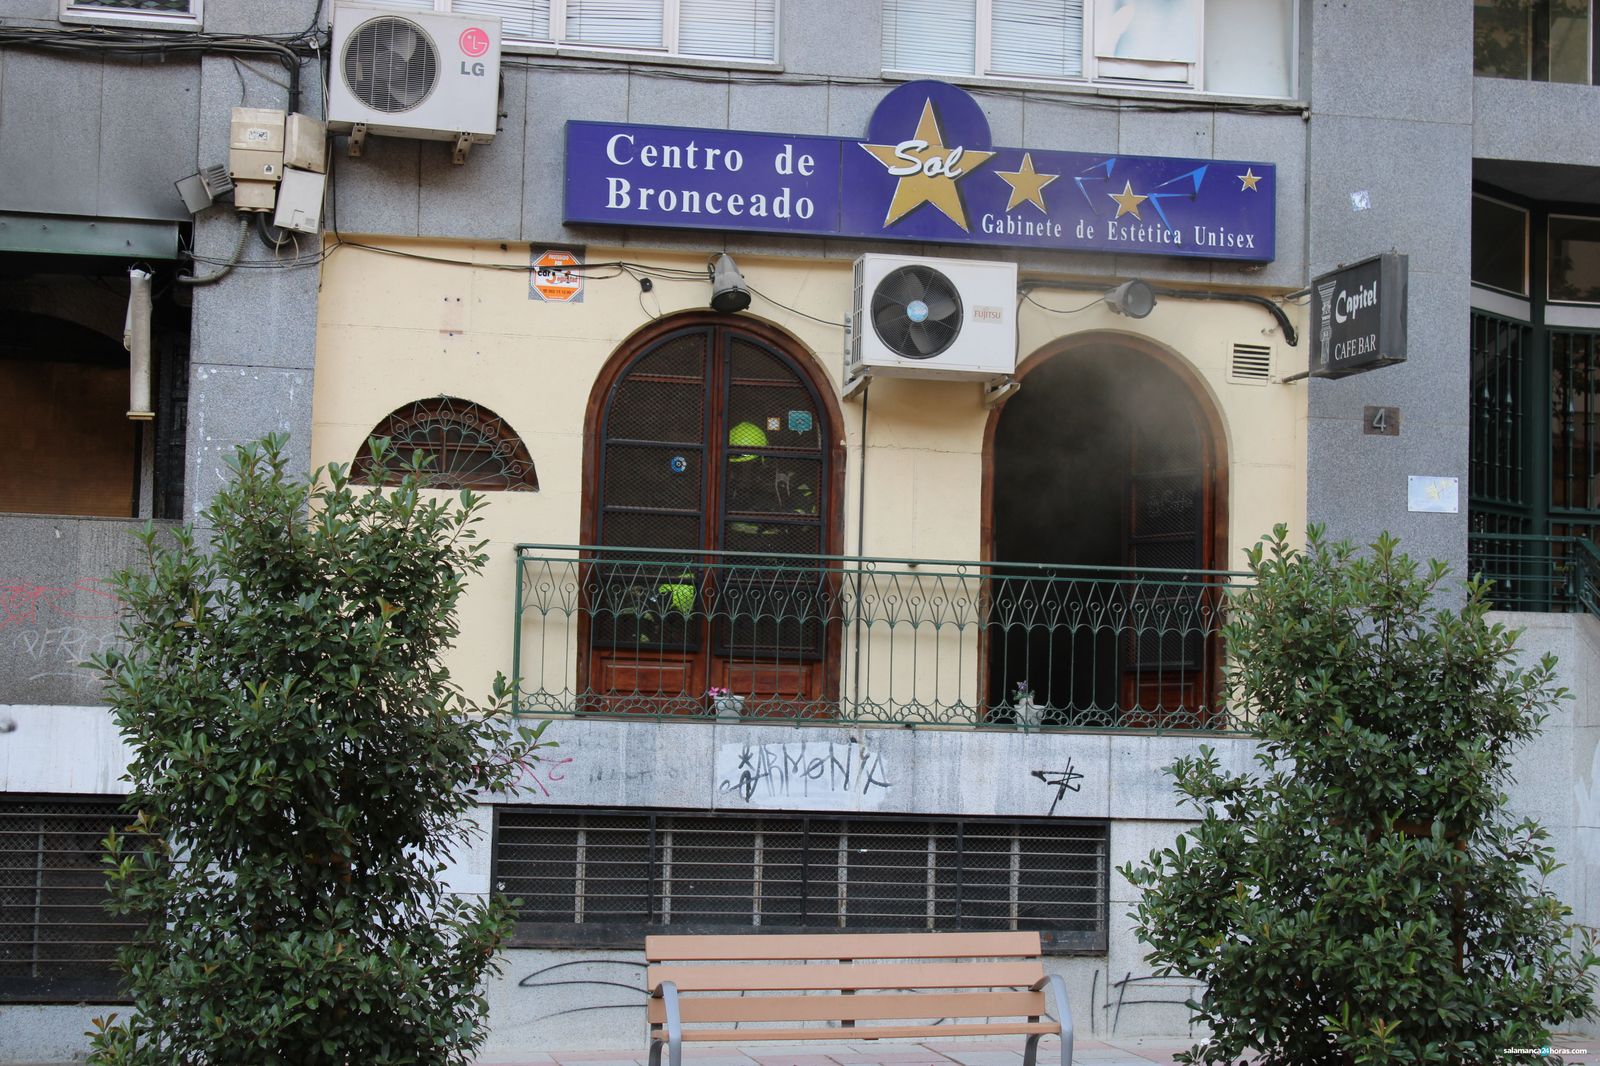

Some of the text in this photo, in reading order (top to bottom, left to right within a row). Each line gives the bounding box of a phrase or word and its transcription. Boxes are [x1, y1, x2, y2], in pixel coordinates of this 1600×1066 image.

[460, 61, 485, 77] LG
[606, 134, 815, 176] Centro de
[887, 139, 963, 178] Sol
[605, 177, 815, 219] Bronceado
[981, 213, 1255, 248] Gabinete de Estética Unisex
[974, 310, 1001, 319] FUJITSU
[1335, 280, 1377, 324] Capitel
[1334, 333, 1376, 361] CAFE BAR
[1372, 408, 1387, 433] 4
